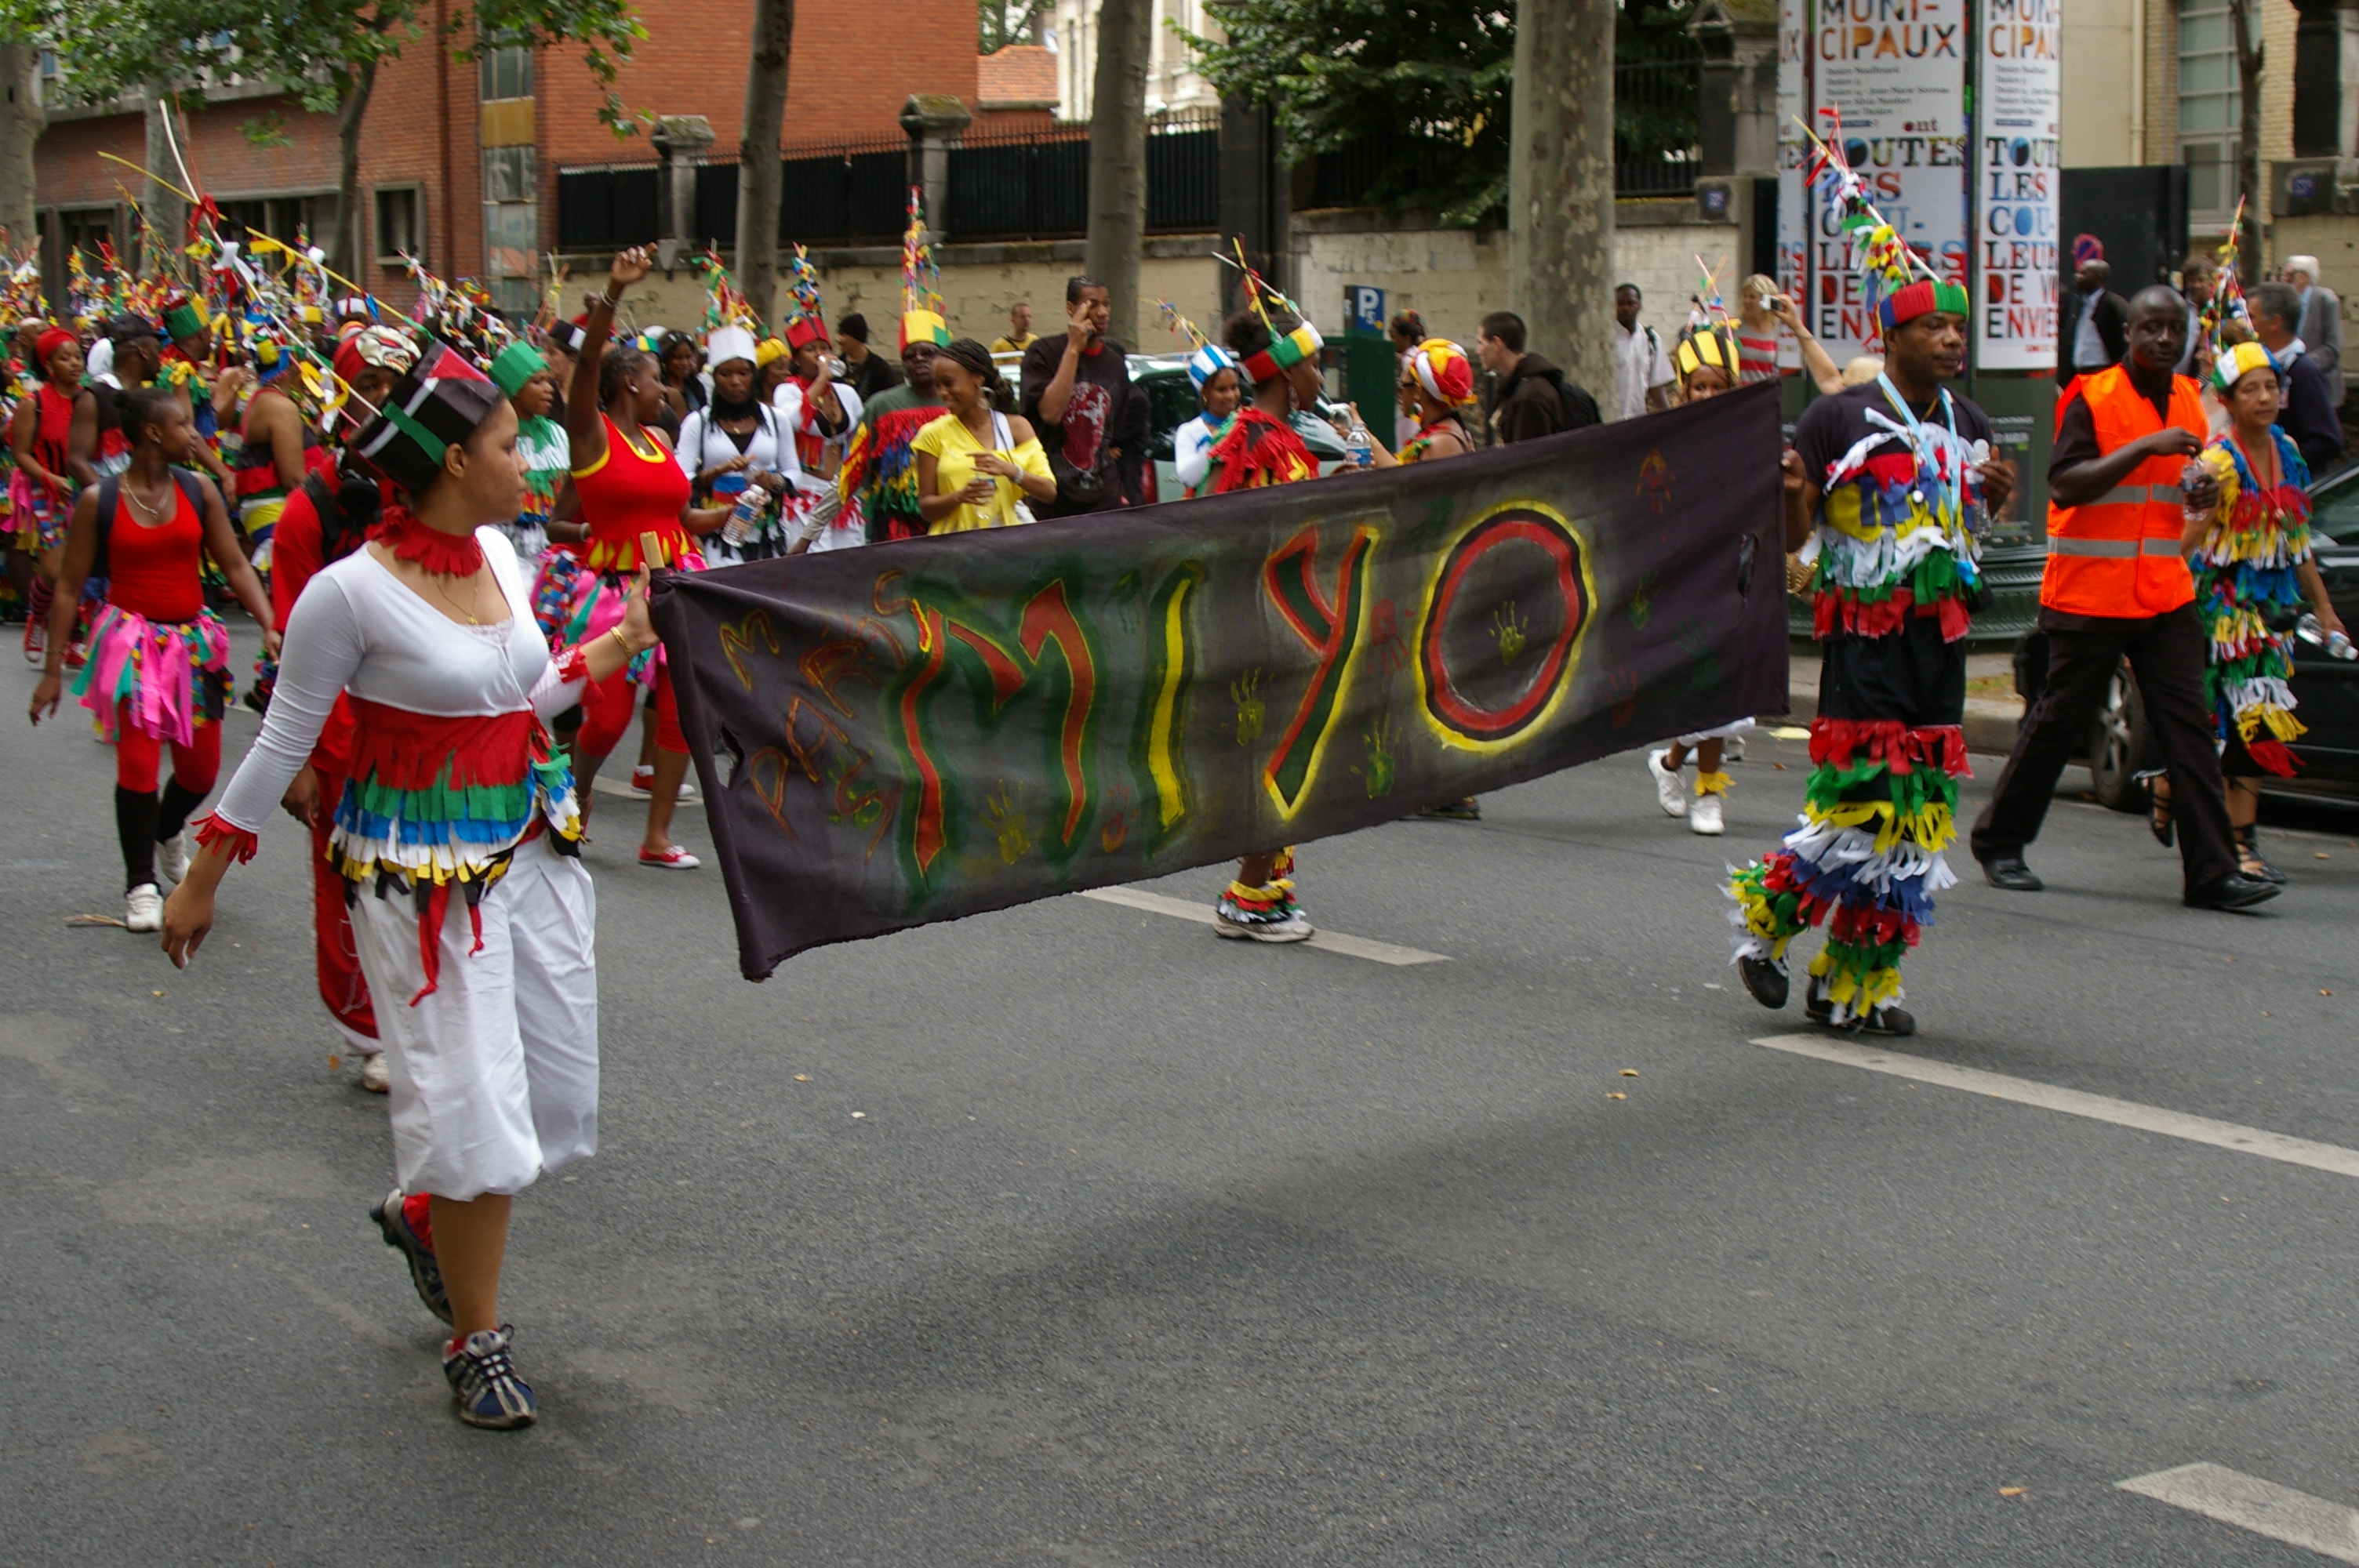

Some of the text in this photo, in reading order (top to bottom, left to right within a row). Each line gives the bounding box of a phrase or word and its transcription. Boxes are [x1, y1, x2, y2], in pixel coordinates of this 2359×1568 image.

[1820, 24, 1958, 60] CIPAUX
[1823, 172, 1901, 201] LS
[1989, 172, 2048, 201] LES
[1822, 206, 1925, 237] CU-
[1989, 206, 2055, 236] COU-
[1822, 274, 1861, 305] DE
[1988, 274, 2023, 304] DE
[896, 499, 1598, 886] MIYO
